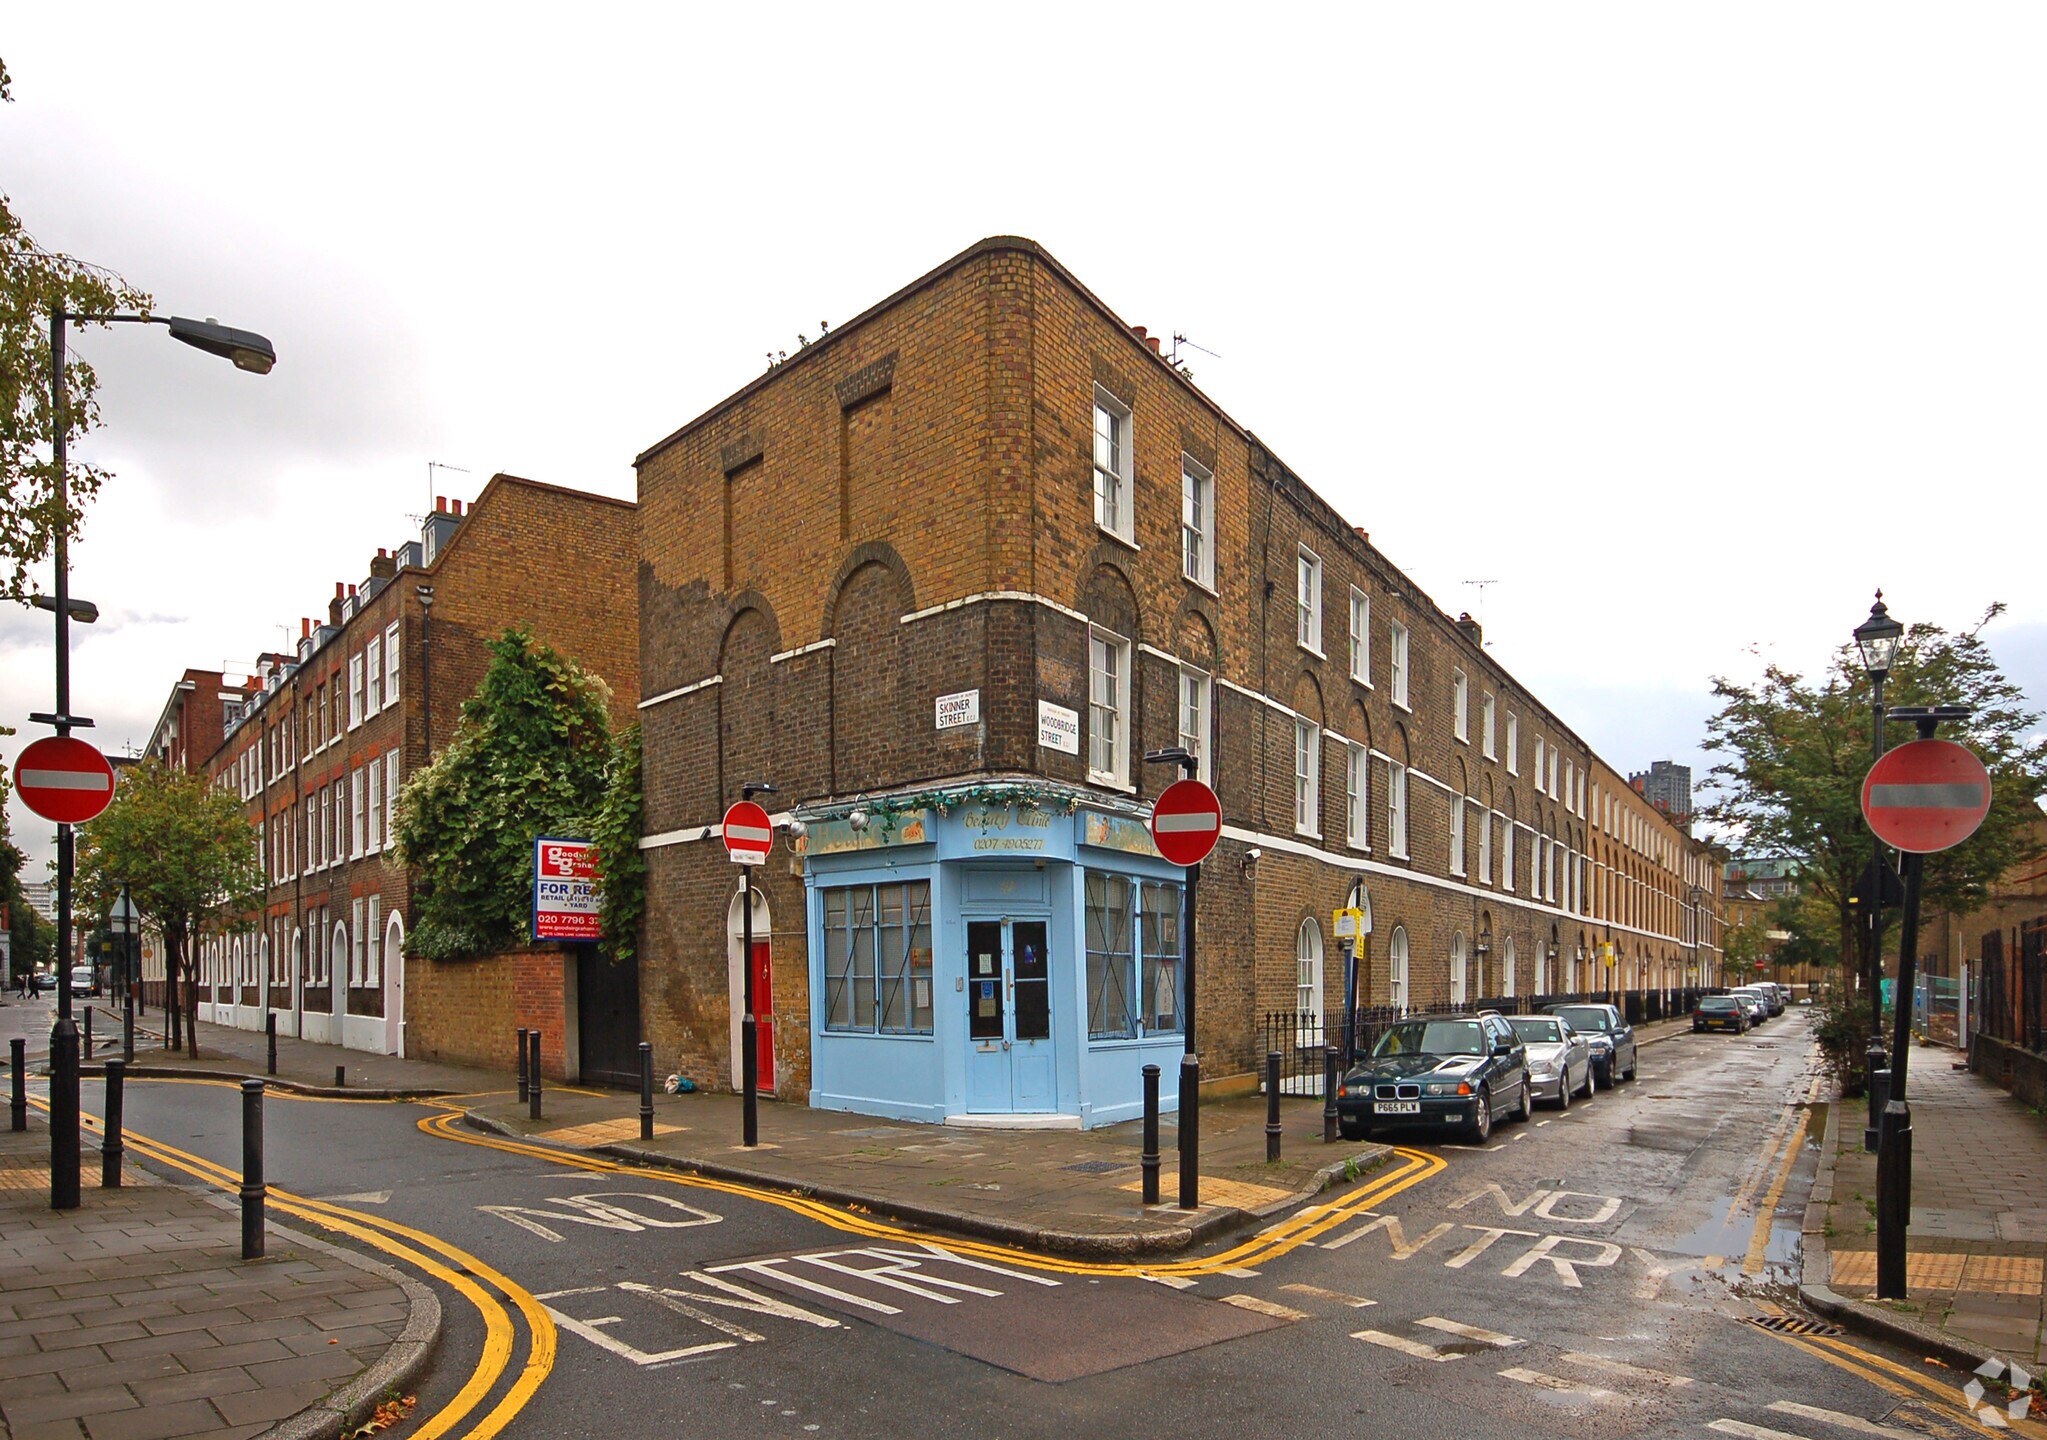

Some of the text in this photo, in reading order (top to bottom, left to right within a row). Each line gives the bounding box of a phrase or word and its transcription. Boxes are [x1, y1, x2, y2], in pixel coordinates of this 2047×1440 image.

[940, 699, 970, 714] SKINNER
[940, 712, 966, 726] STREET
[1041, 714, 1076, 735] WOODBRIDGE
[1041, 730, 1062, 745] STREET
[974, 839, 999, 850] 0207
[540, 883, 568, 894] FOR
[538, 914, 558, 923] 020
[561, 916, 585, 924] 7796
[1378, 1103, 1399, 1112] P665
[1447, 1184, 1622, 1223] NO
[476, 1192, 723, 1242] NO
[511, 1243, 1063, 1365] ENTRY
